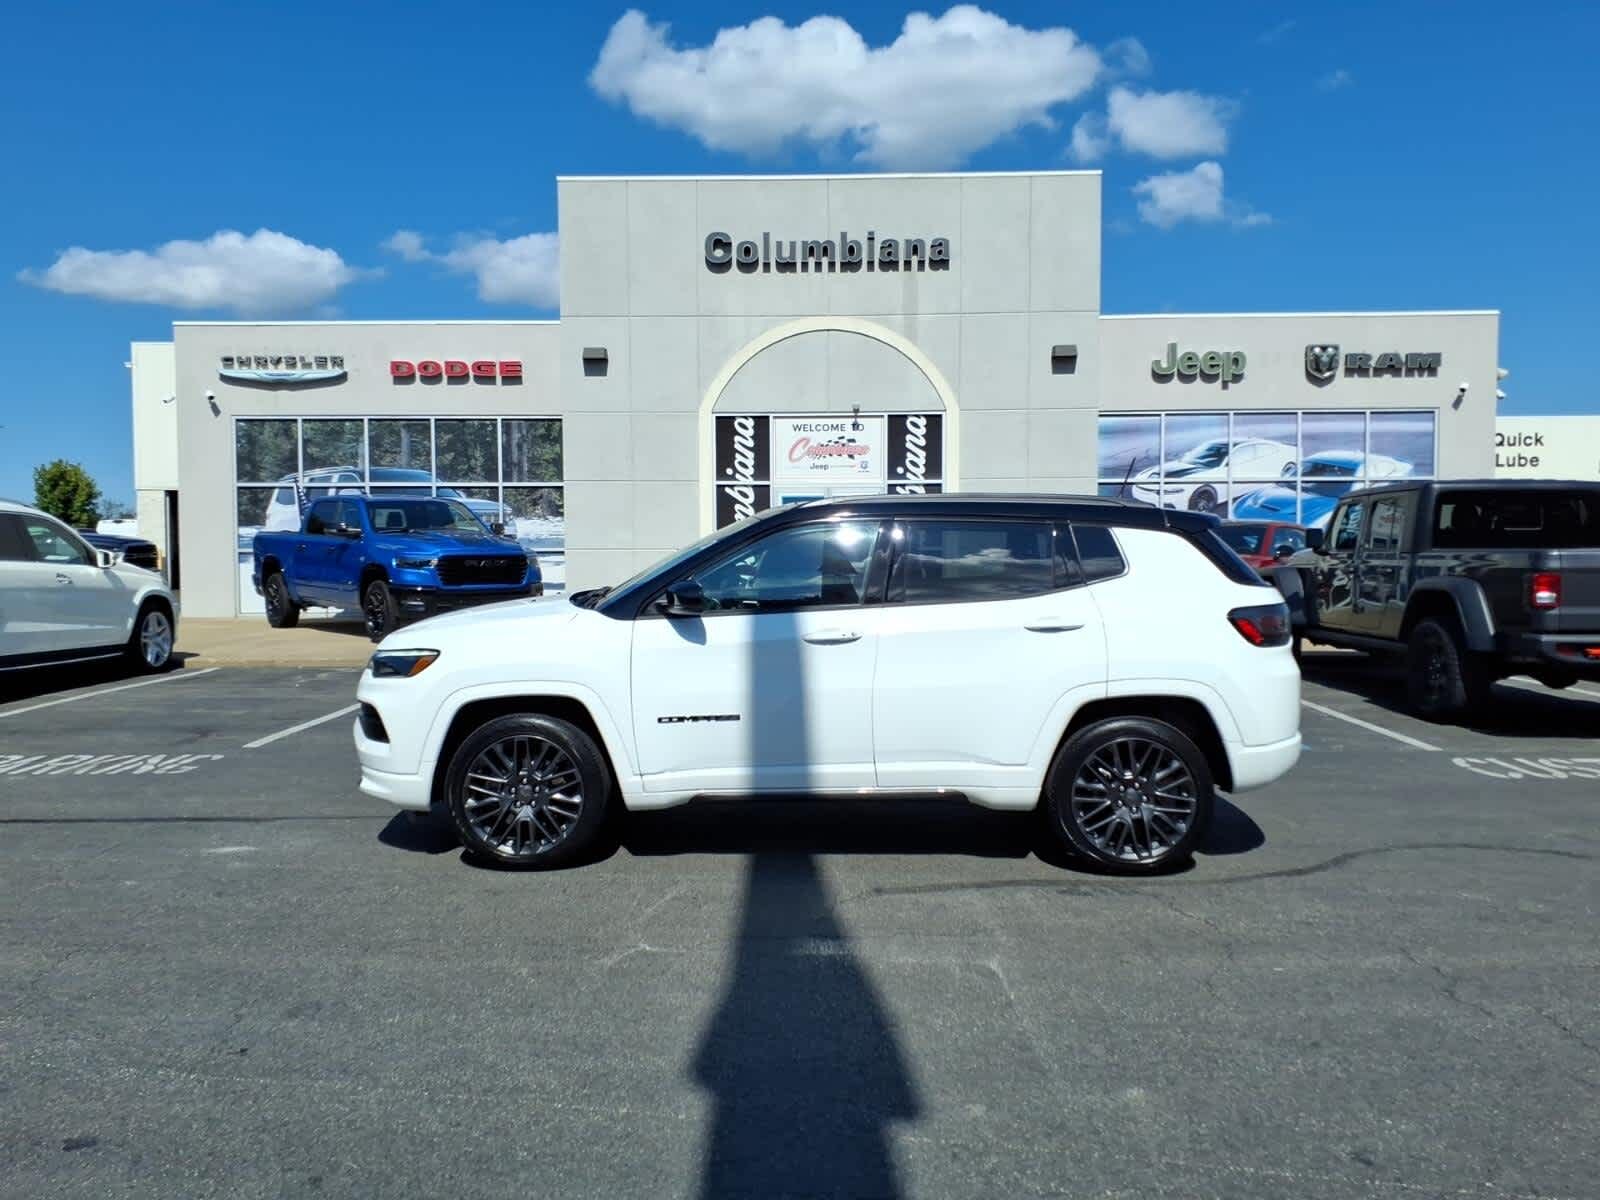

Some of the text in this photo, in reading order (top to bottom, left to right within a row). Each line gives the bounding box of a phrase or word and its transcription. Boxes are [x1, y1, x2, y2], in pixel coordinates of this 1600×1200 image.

[703, 230, 951, 265] Columbiana
[220, 355, 345, 369] CHRYSLER
[389, 360, 523, 377] DODGE
[1151, 341, 1248, 382] Jeep
[1344, 352, 1442, 370] RAM
[792, 423, 846, 432] WELCOME
[1495, 432, 1545, 447] Quick
[1495, 453, 1541, 467] Lube
